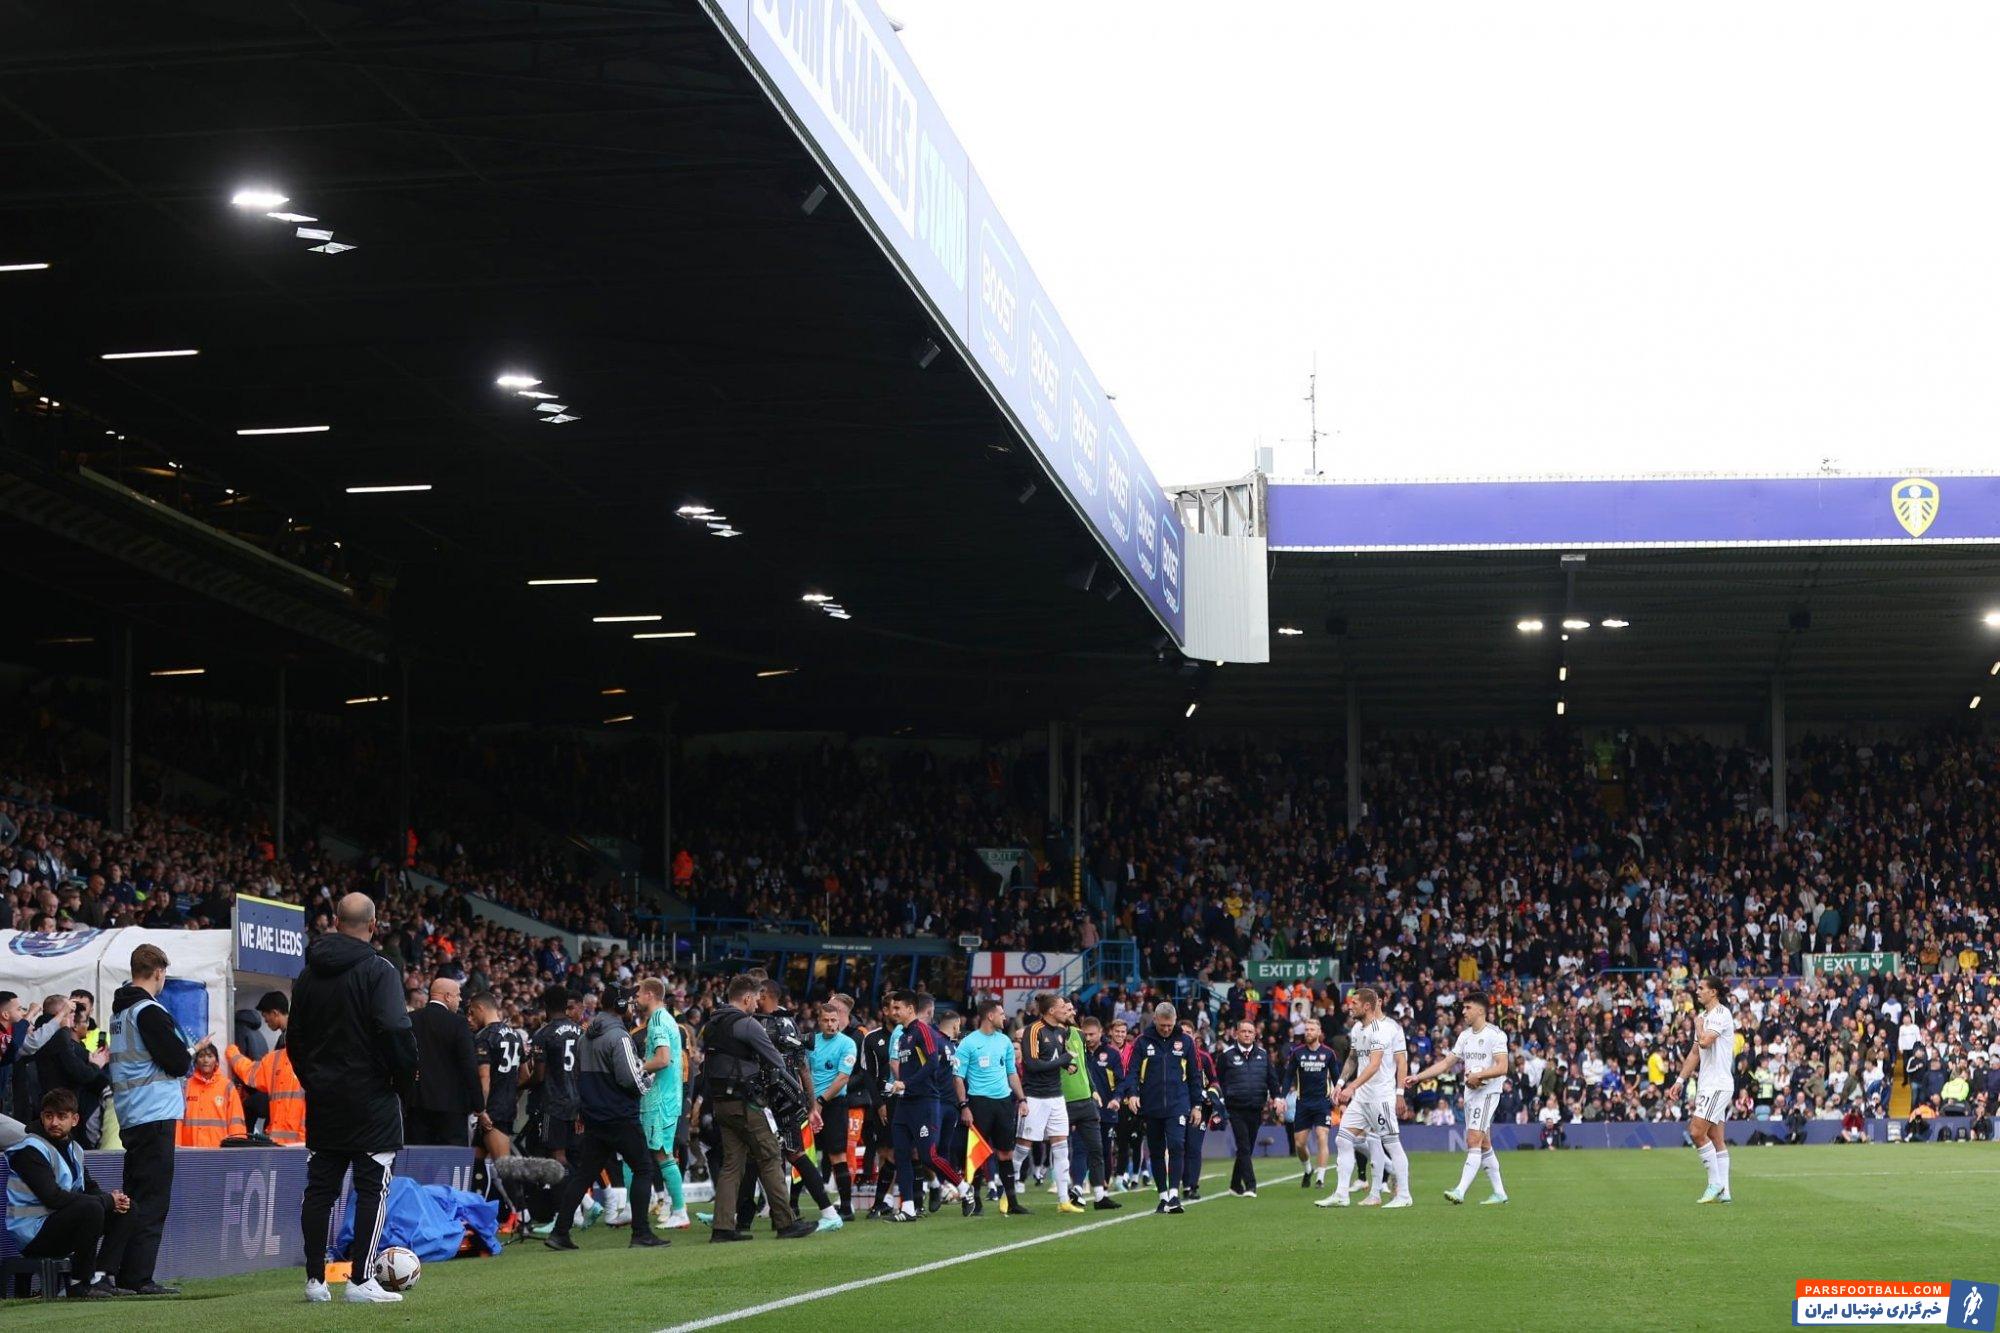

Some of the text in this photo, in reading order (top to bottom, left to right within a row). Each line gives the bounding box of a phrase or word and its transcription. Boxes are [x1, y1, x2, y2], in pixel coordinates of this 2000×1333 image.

[830, 0, 912, 213] CHARLES
[918, 129, 967, 293] STAND
[983, 250, 1016, 341] BOOST
[1031, 328, 1060, 408] BOOST
[1072, 397, 1098, 467] BOOST
[1108, 449, 1129, 511] BOOST
[1138, 498, 1155, 553] BOOST
[1163, 536, 1179, 589] BOOST
[240, 921, 303, 957] WE ARE LEEDS
[1259, 963, 1293, 977] EXIT
[1823, 957, 1858, 972] EXIT
[497, 1041, 520, 1074] 34
[563, 1039, 576, 1072] 5
[1473, 1108, 1481, 1119] 8
[1699, 1095, 1710, 1108] 21
[1377, 1114, 1386, 1126] 6
